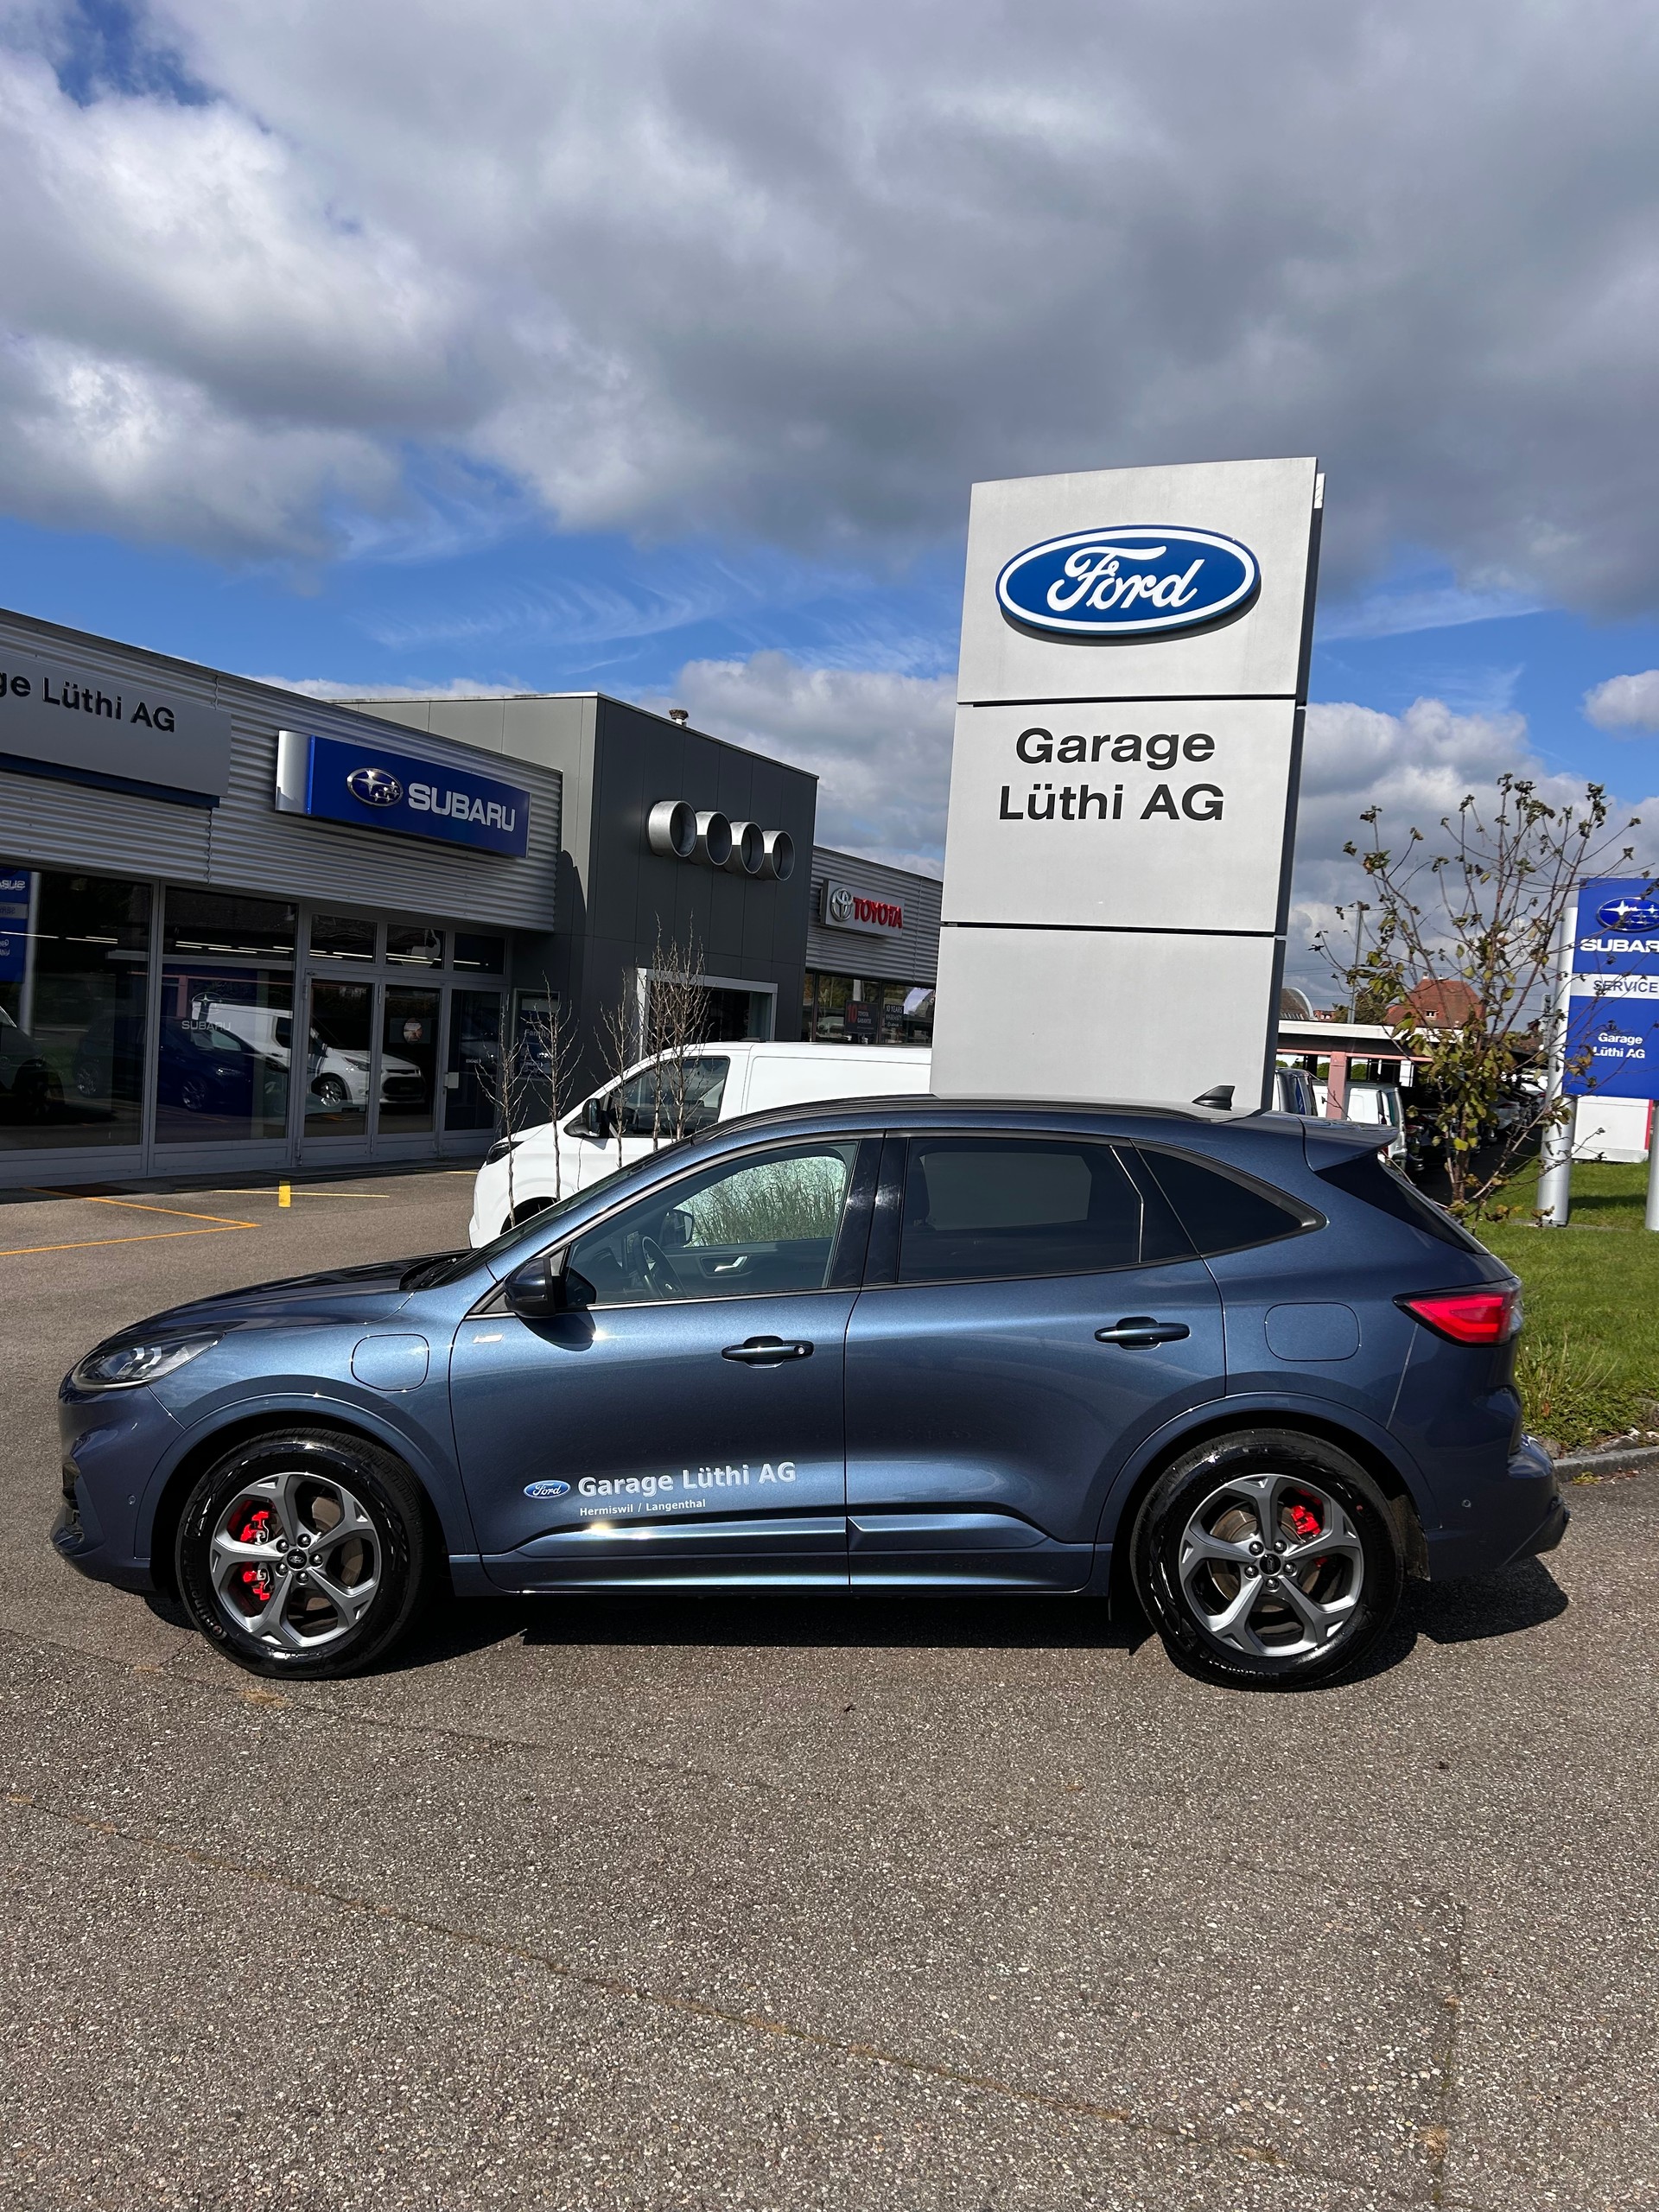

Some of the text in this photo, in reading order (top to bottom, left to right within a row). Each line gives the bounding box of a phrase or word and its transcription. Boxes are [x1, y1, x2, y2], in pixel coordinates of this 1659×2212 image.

[1046, 545, 1205, 612] Ford
[43, 677, 122, 720] Lüthi
[130, 702, 175, 733] AG
[1015, 727, 1216, 771] Garage
[408, 782, 516, 832] SUBARU
[999, 784, 1224, 821] Lüthi AG
[853, 897, 903, 929] TOYOTA
[1592, 980, 1658, 994] SERVICE
[181, 1020, 232, 1031] SUBARU
[1598, 1033, 1643, 1046] Garage
[1593, 1046, 1645, 1059] Lüthi AG
[532, 1461, 796, 1498] Ford Garage Lüthi AG
[580, 1504, 633, 1516] Hermiswil
[646, 1498, 706, 1512] Langenthal
